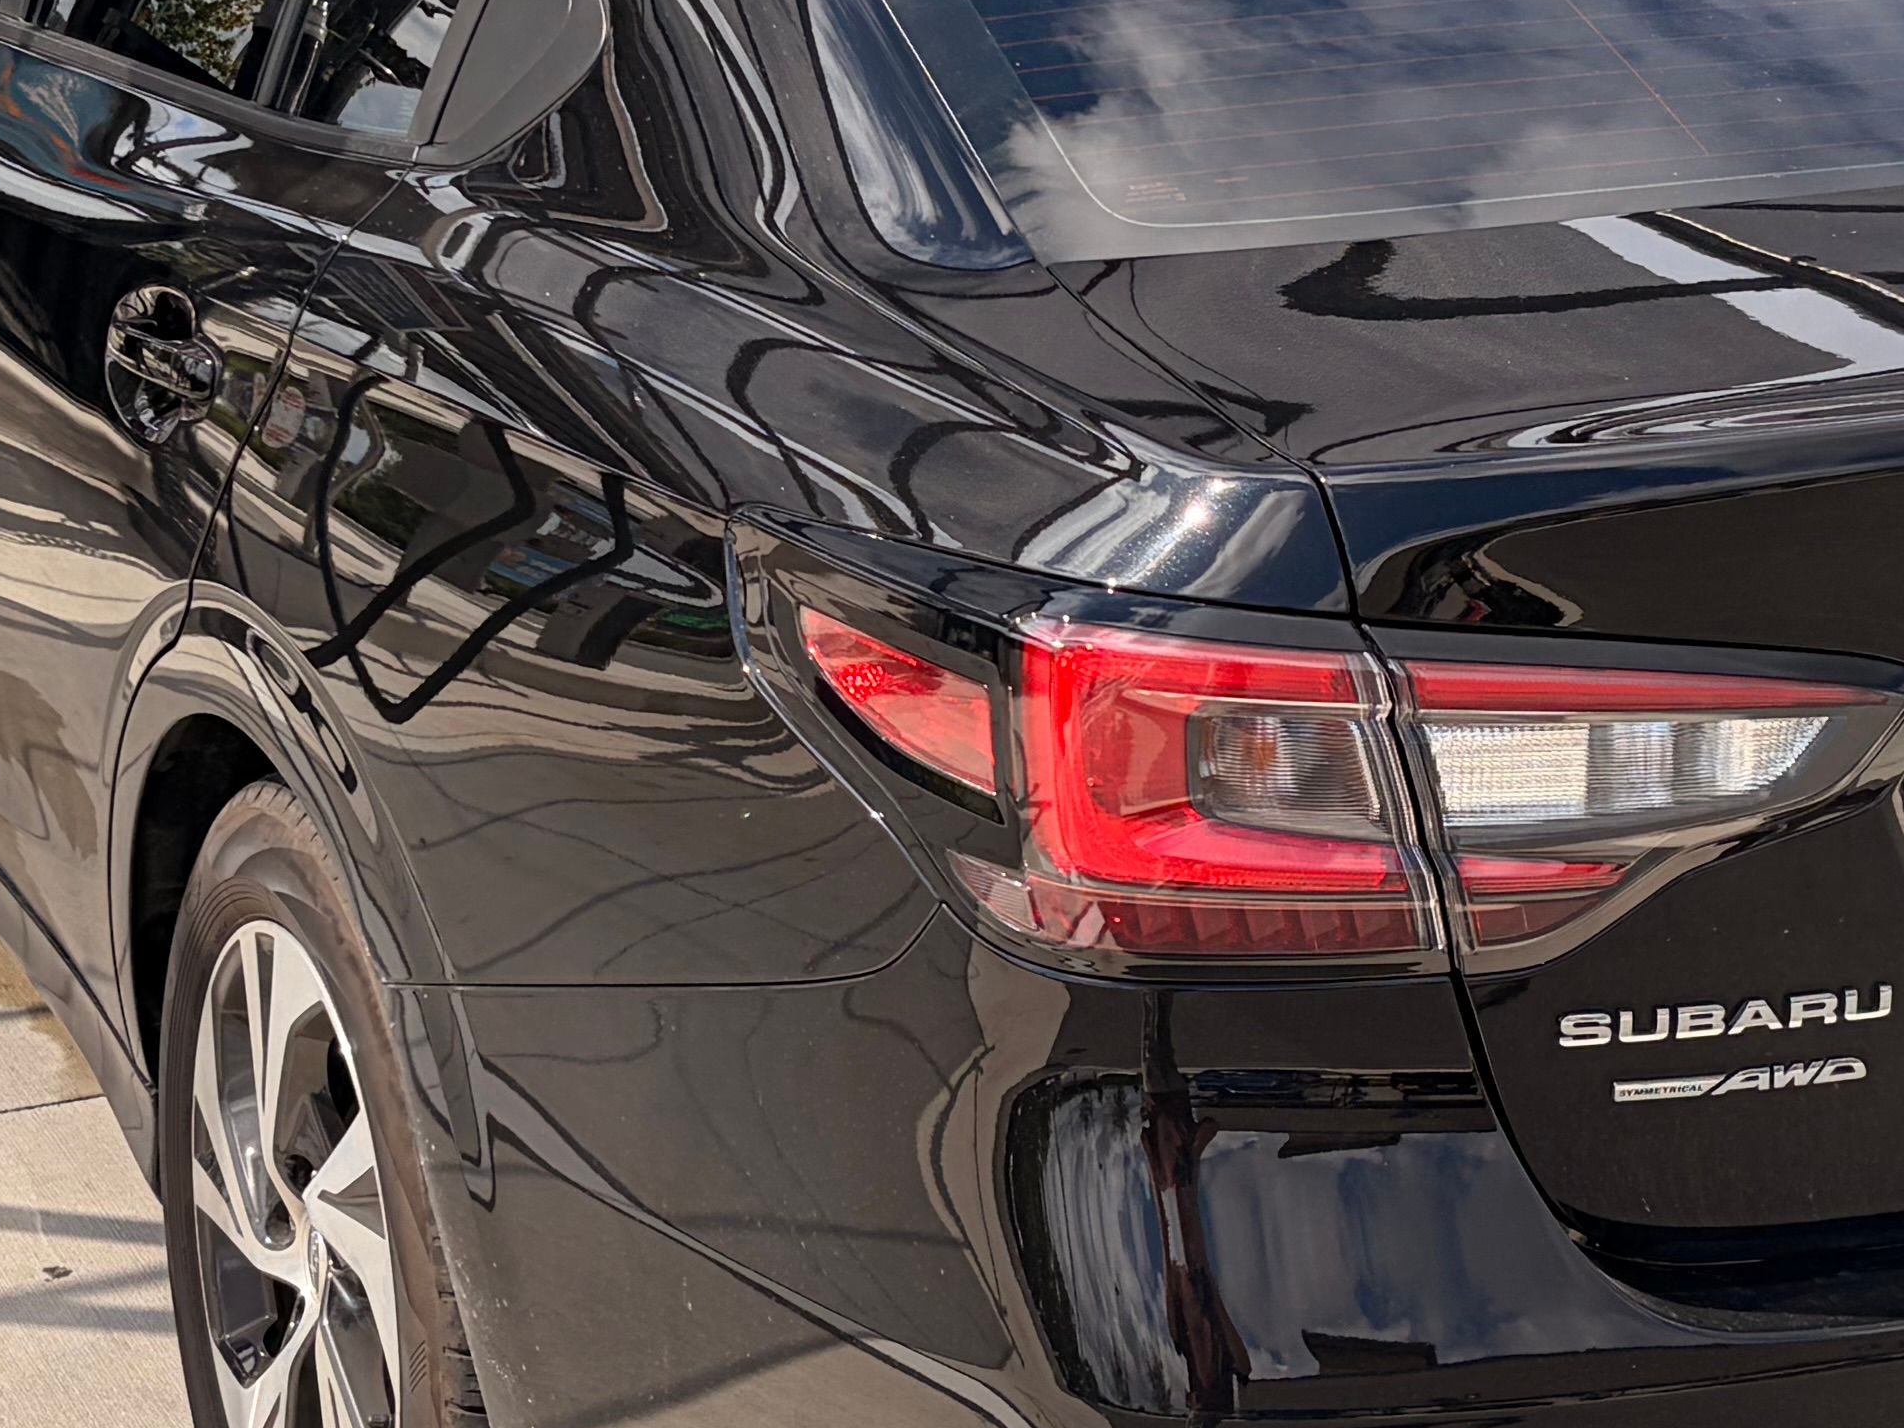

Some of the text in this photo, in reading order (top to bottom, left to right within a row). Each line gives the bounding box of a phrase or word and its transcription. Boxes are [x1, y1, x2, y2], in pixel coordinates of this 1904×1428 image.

[1558, 981, 1893, 1049] SUBARU
[1618, 1056, 1868, 1098] SYMMETRICAL AWD
